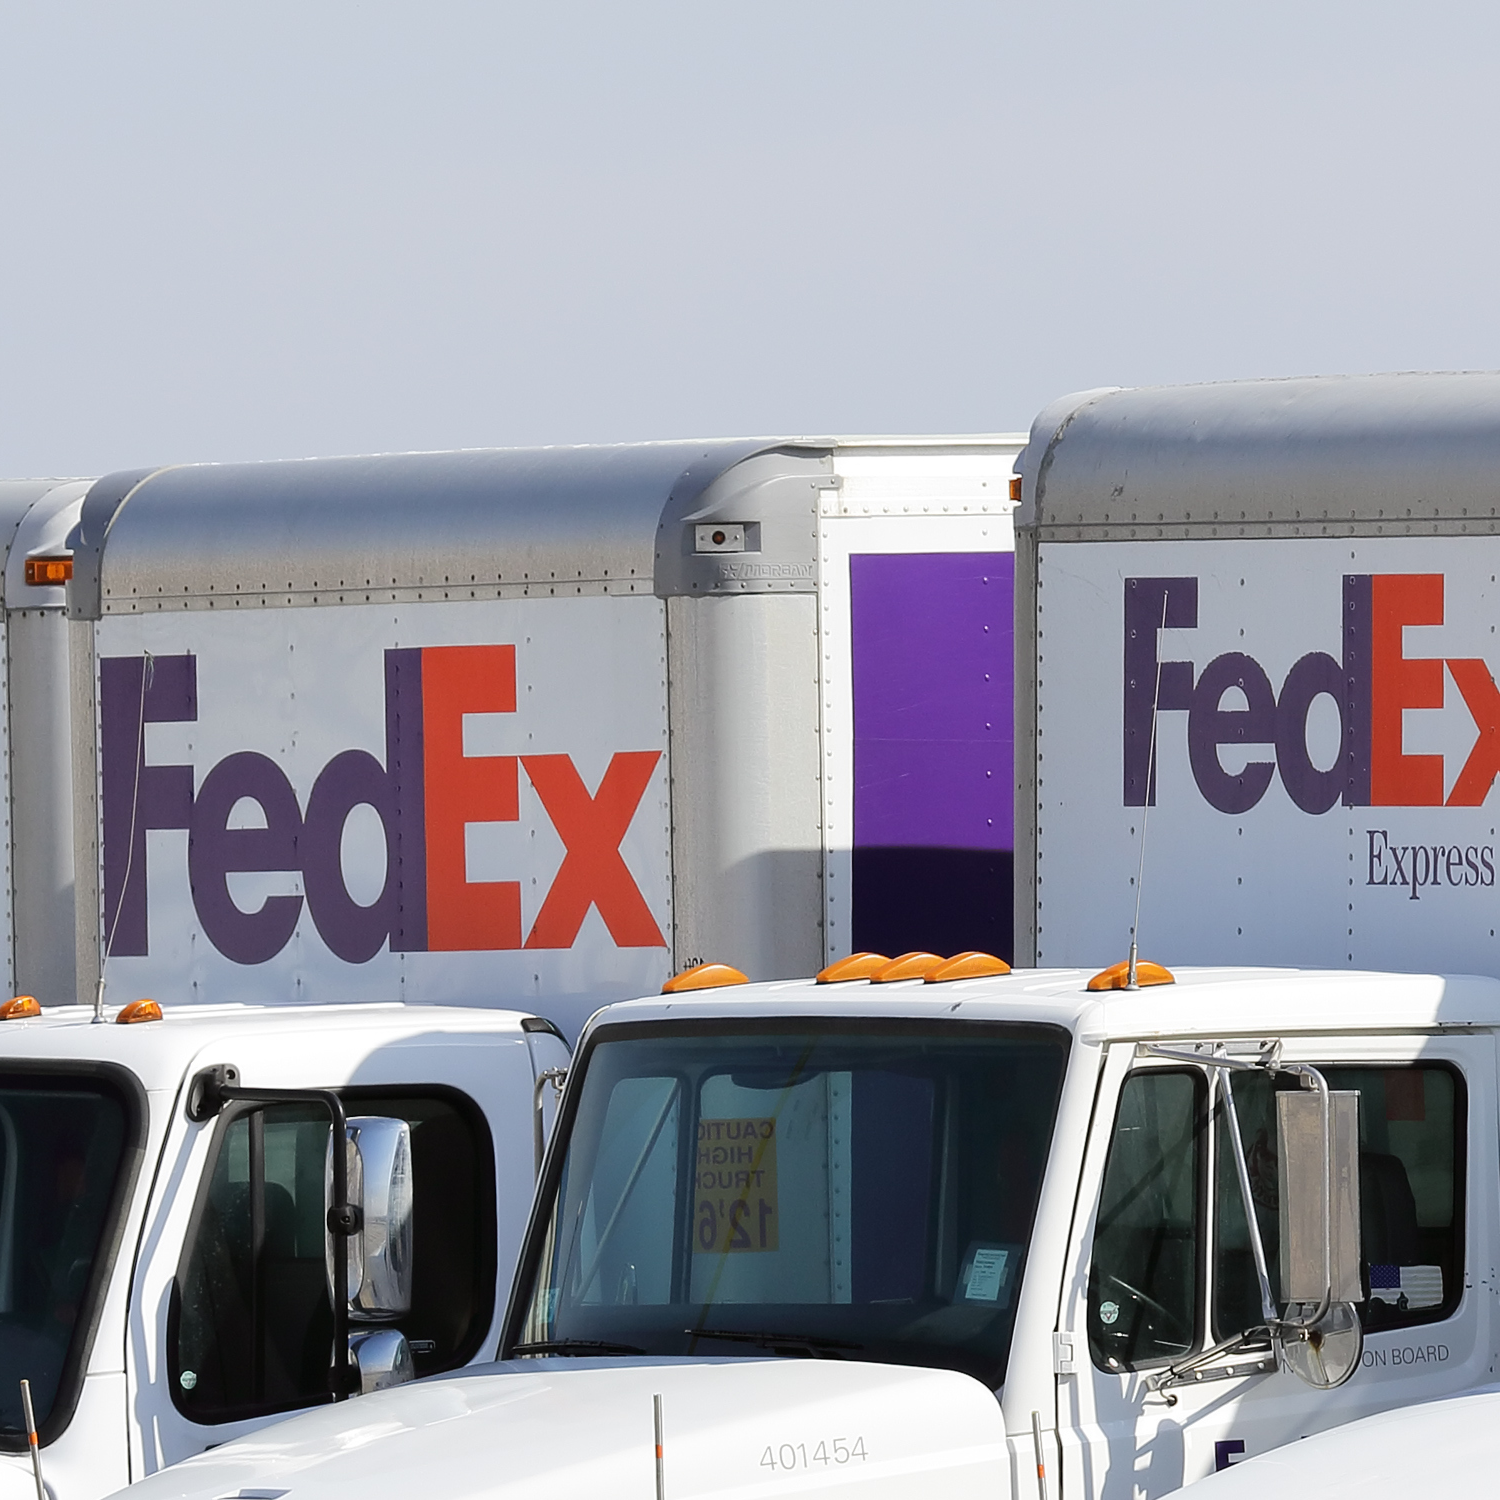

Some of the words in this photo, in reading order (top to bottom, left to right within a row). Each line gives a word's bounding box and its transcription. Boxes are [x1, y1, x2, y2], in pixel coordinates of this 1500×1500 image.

[101, 644, 666, 964] FedEx
[1366, 830, 1495, 900] Express
[1362, 1349, 1387, 1368] ON
[1391, 1344, 1450, 1366] BOARD
[759, 1436, 869, 1471] 401454
